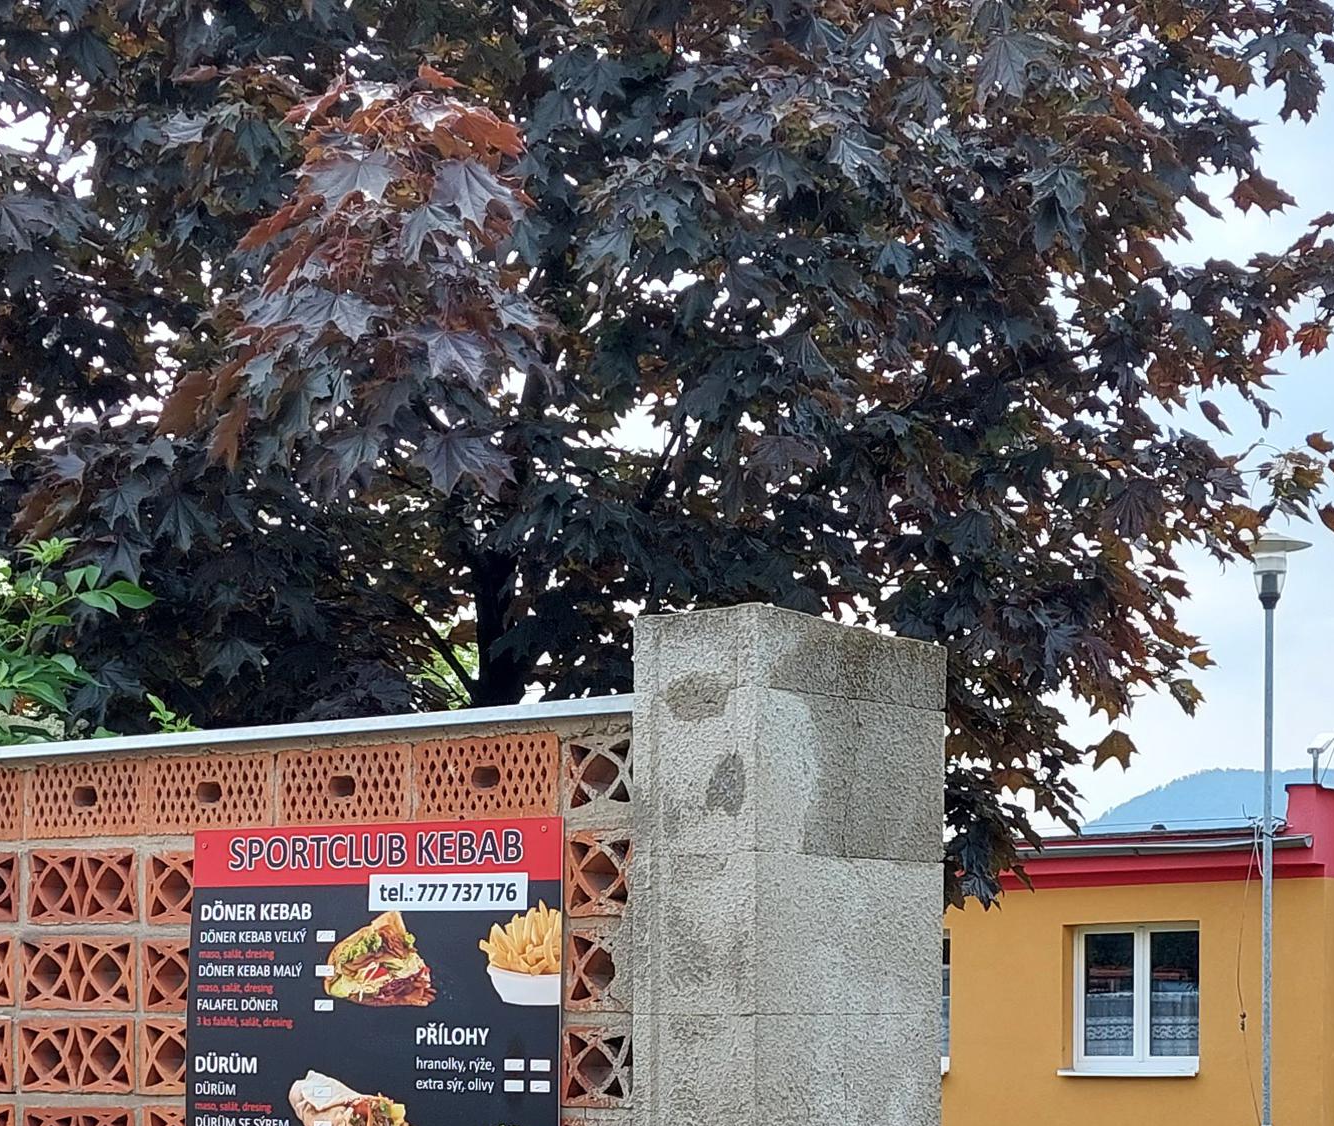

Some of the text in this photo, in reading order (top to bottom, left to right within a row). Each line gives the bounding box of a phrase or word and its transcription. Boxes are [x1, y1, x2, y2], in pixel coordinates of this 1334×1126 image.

[228, 829, 523, 870] SPORTCLUB KEBAB
[379, 883, 517, 902] tel.: 777 737 176
[200, 901, 312, 921] DÖNER KEBAB
[200, 928, 307, 943] DÖNER KEBAB VELKÝ
[198, 962, 302, 977] DÖNER KEBAB MALÝ
[197, 997, 278, 1011] FALAFEL DÖNER
[416, 1022, 489, 1045] PŘÍLOHY
[195, 1052, 257, 1074] DÜRÜM
[416, 1056, 495, 1072] hranolky, rýže,
[195, 1081, 236, 1095] DÜRÜM
[416, 1078, 494, 1093] extra sýr, olivy
